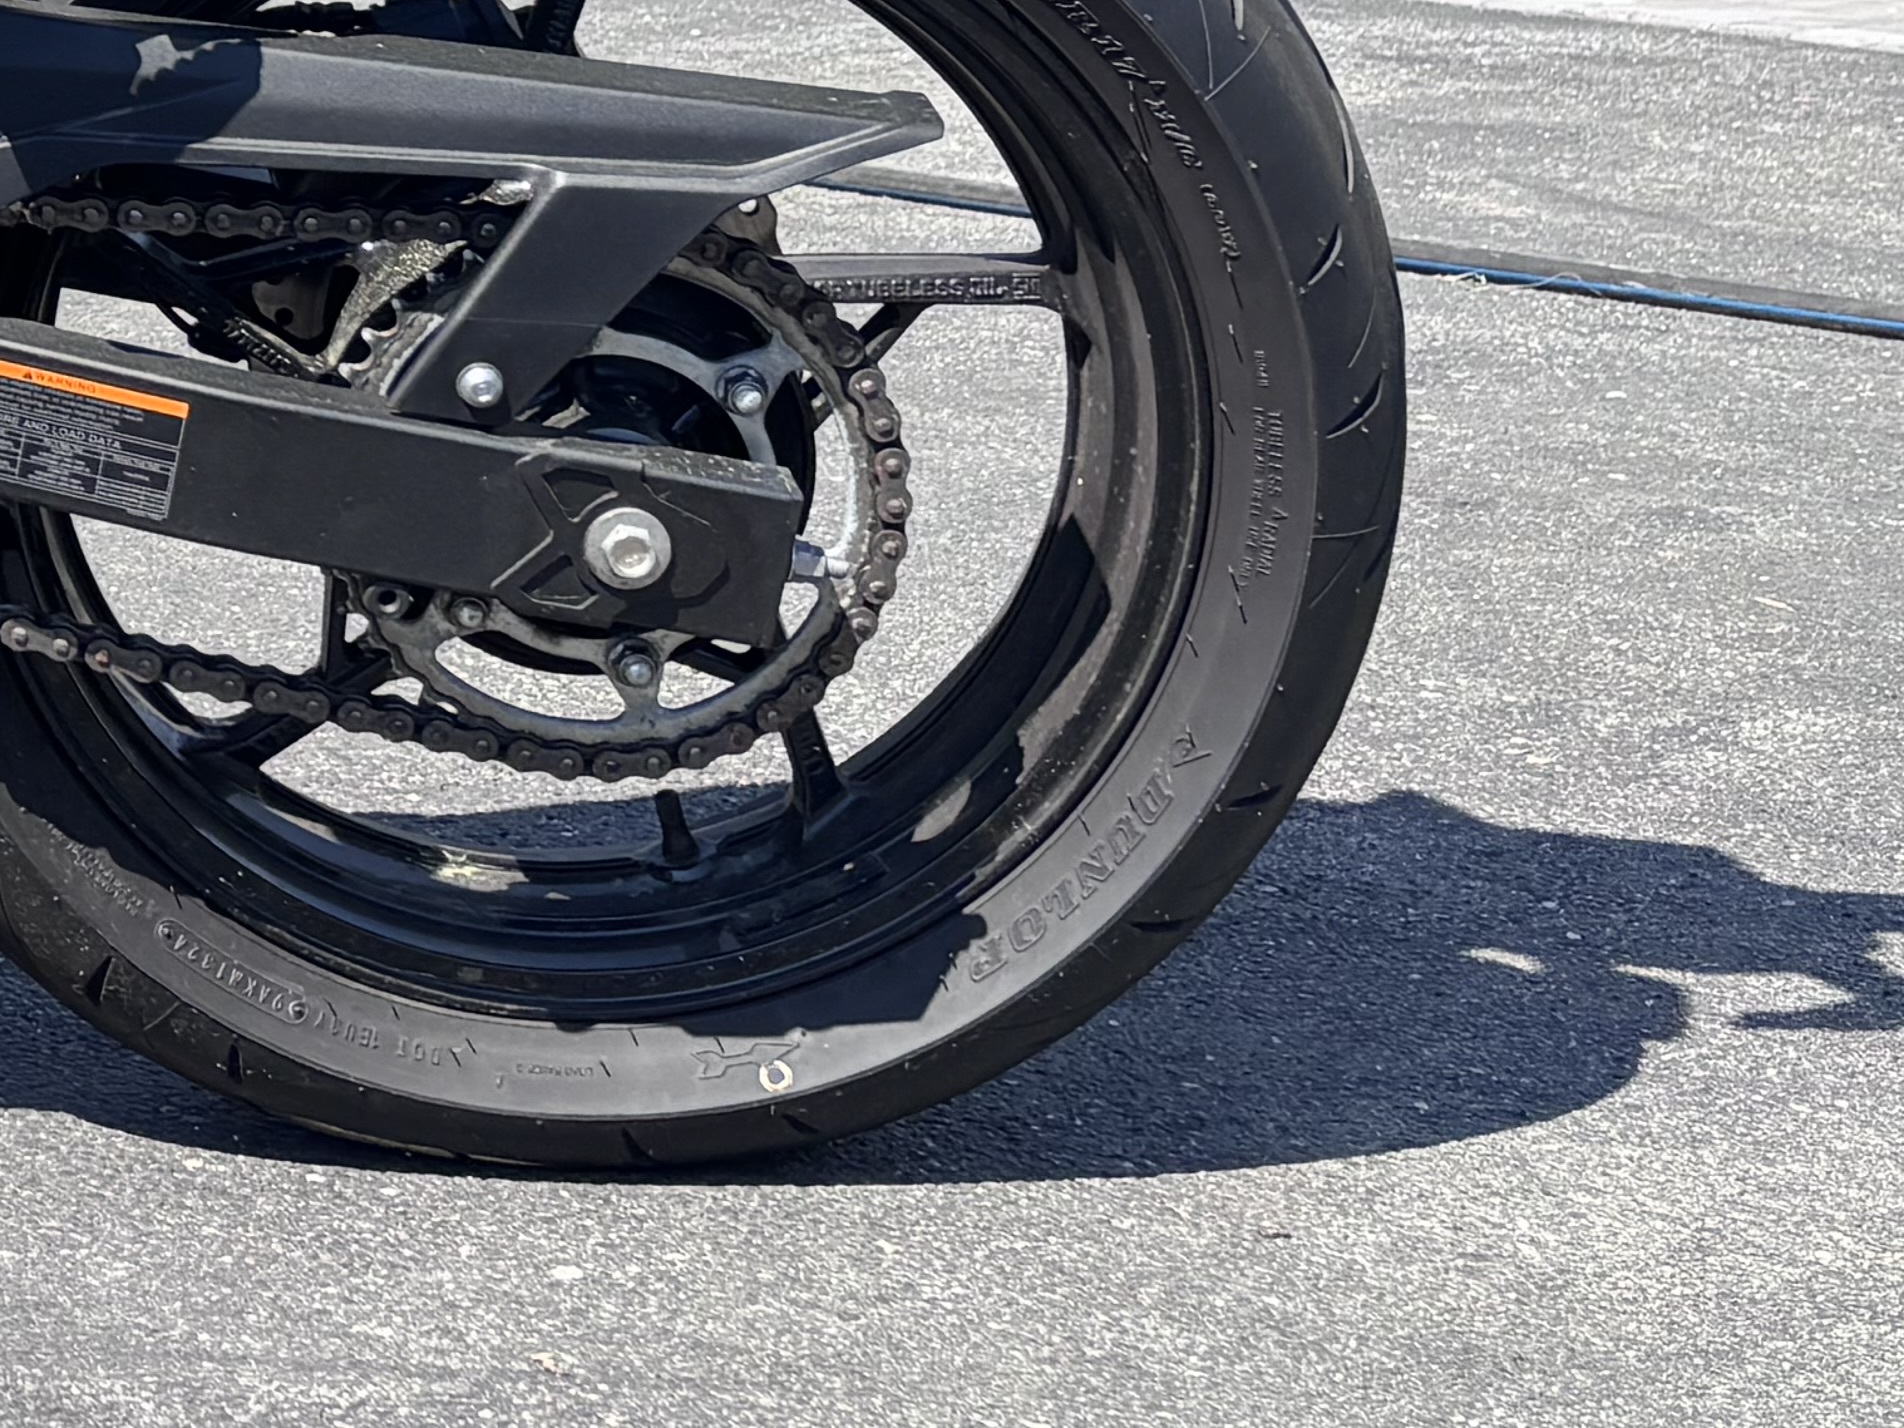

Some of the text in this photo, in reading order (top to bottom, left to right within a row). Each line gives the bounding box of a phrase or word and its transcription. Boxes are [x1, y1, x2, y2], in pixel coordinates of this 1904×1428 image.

[35, 372, 97, 395] WARNING
[22, 418, 50, 435] AND
[88, 434, 123, 450] DATA
[969, 773, 1176, 983] DUNLOP
